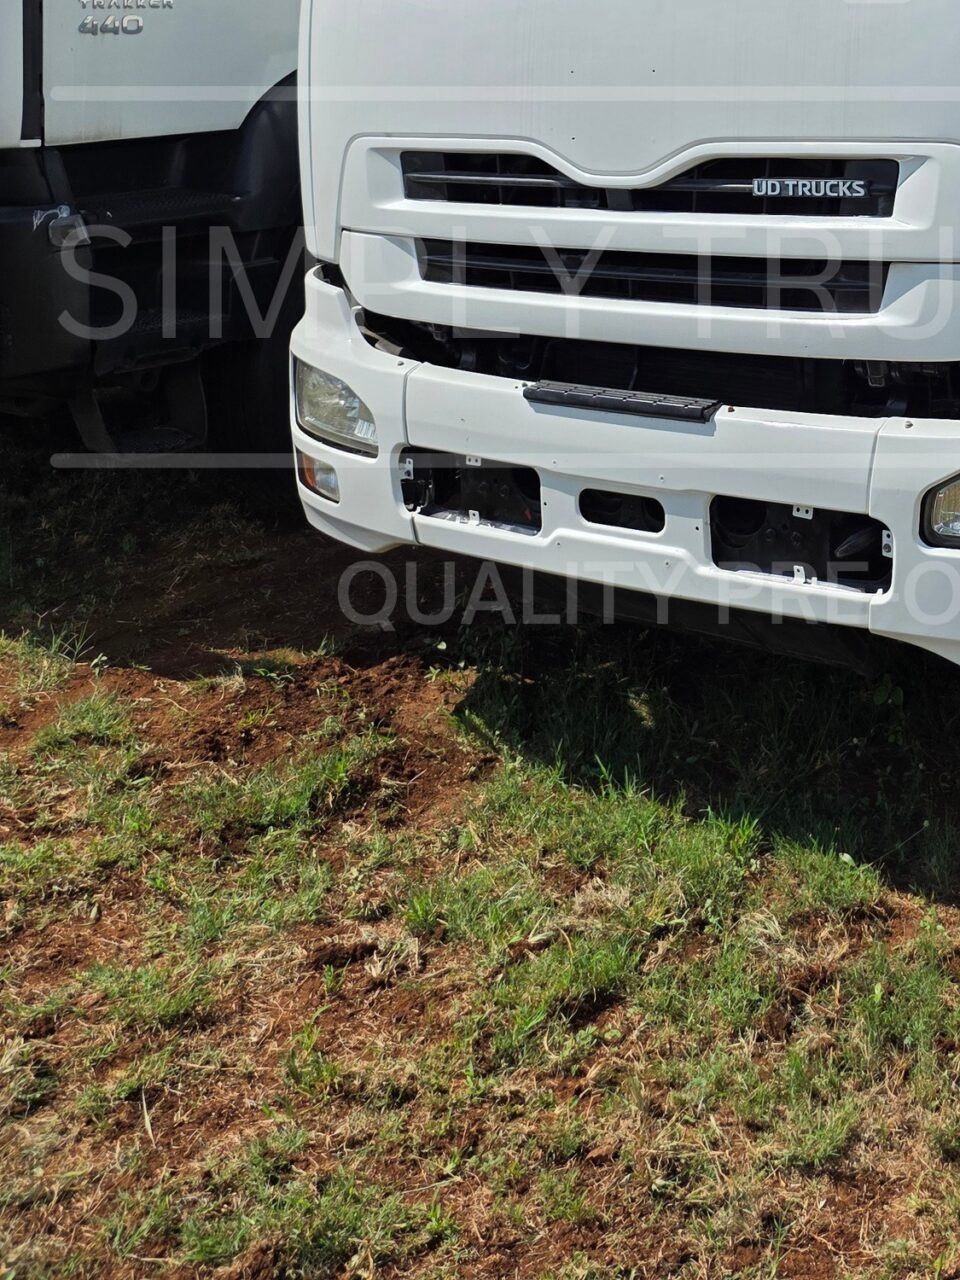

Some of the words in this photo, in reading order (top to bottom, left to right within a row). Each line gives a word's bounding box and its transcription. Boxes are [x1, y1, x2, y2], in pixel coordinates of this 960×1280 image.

[78, 15, 144, 35] 440
[754, 180, 781, 196] UD
[786, 180, 865, 196] TRUCKS
